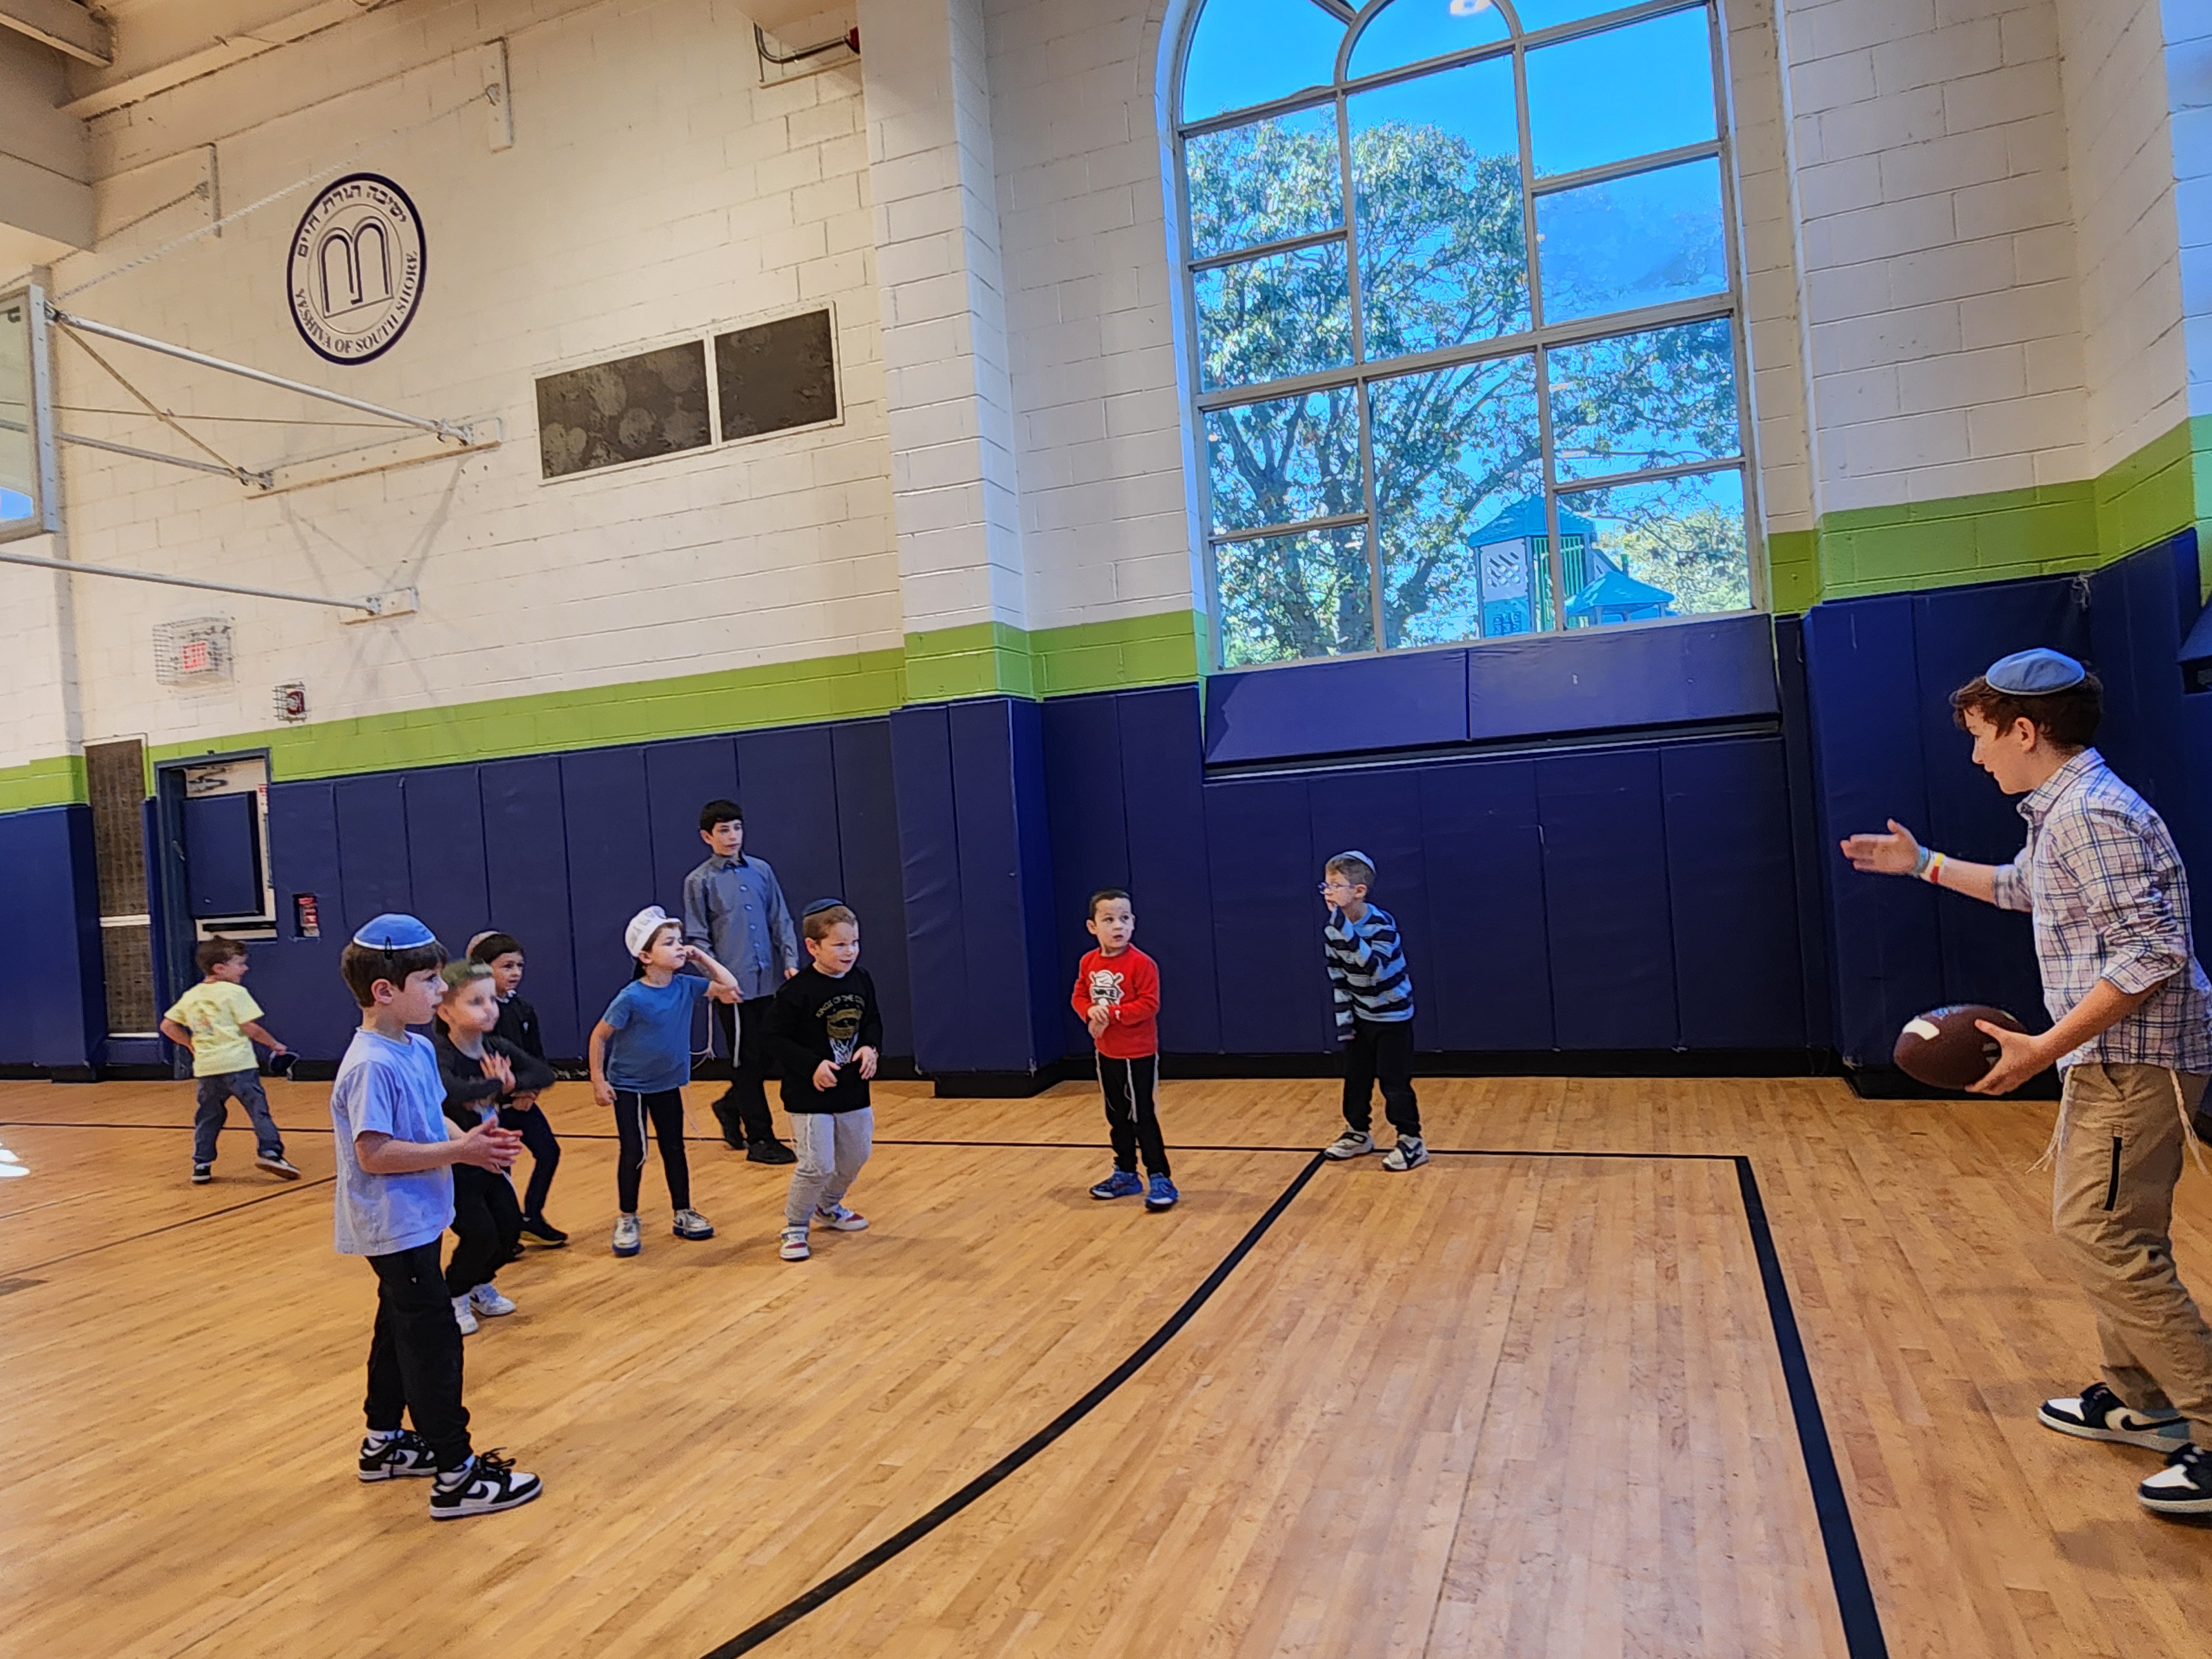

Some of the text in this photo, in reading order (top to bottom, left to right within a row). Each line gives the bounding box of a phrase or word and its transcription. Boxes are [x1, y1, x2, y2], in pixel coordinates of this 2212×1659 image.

[296, 185, 407, 258] ישיבה תורת חיים
[295, 251, 418, 354] YESHIVA OF SOUTH SHORE
